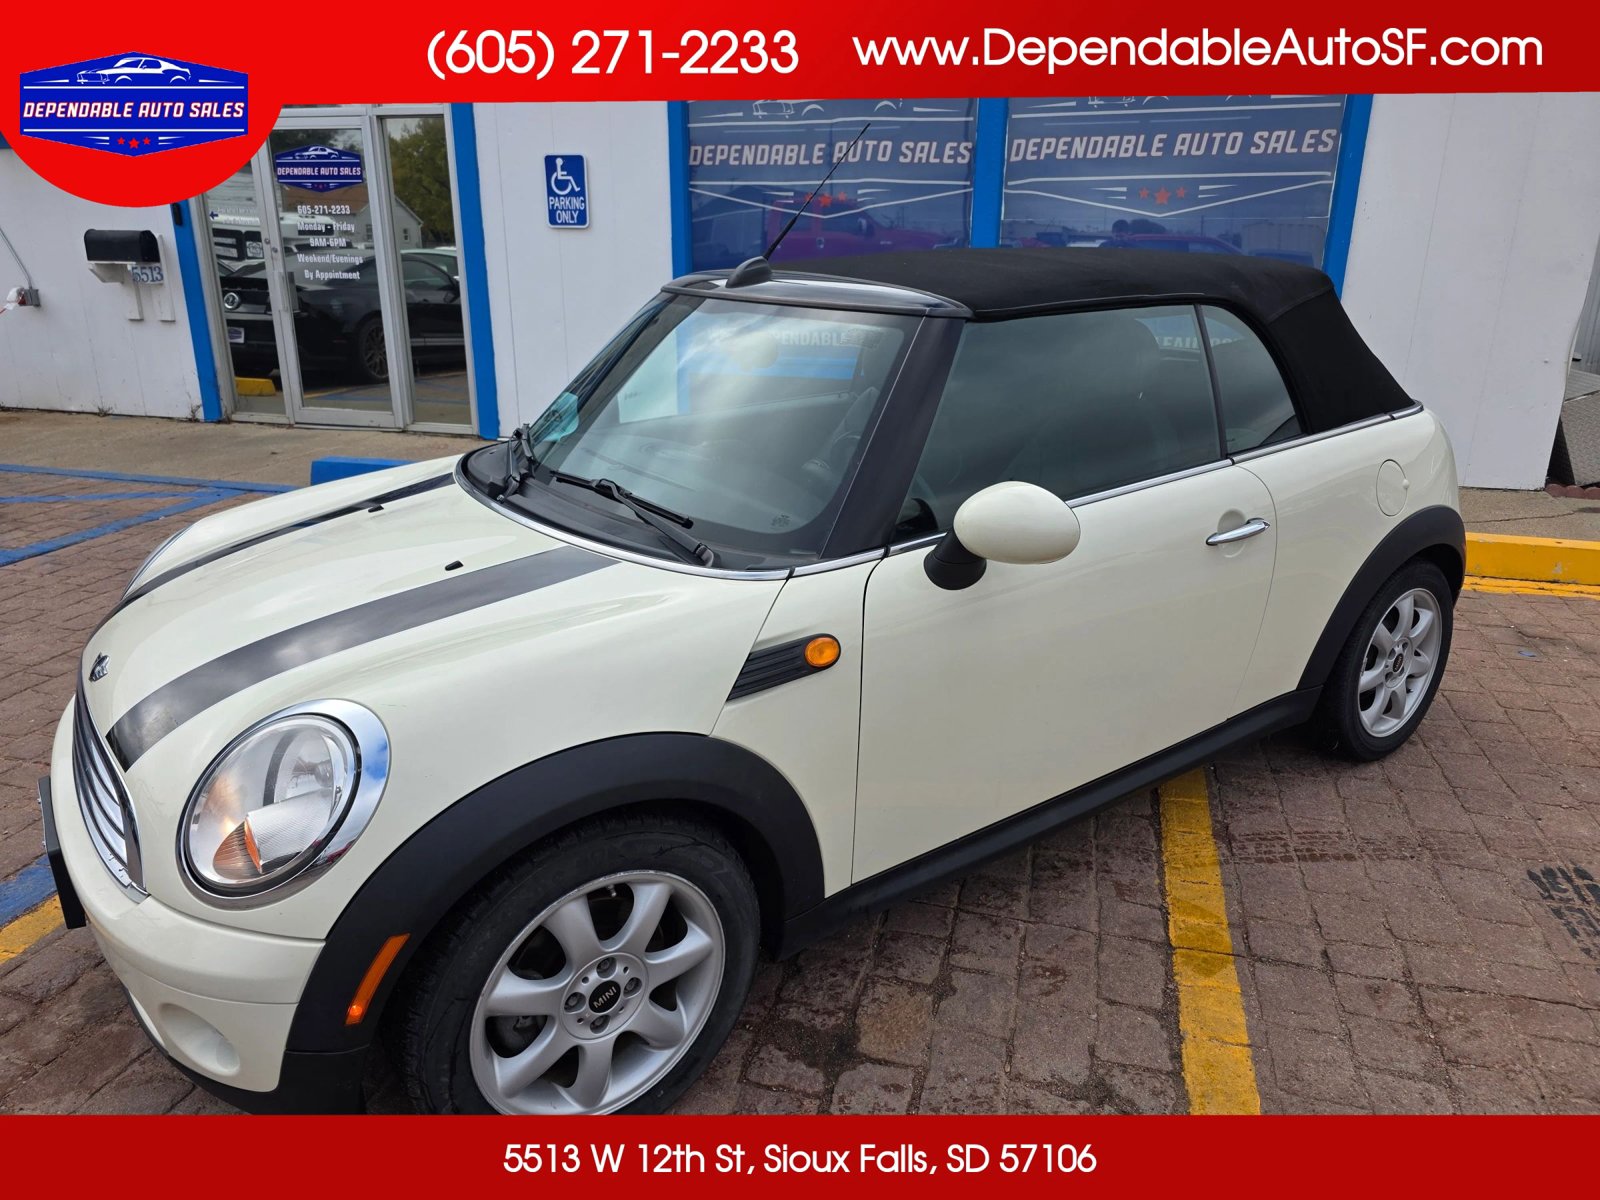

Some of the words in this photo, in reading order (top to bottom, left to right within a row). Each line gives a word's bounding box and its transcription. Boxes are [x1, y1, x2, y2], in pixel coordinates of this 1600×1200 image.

[1009, 133, 1168, 163] DEPENDABLE
[1173, 131, 1245, 157] AUTO
[1250, 128, 1337, 155] SALES
[688, 143, 826, 166] DEPENDABLE
[832, 140, 893, 164] AUTO
[899, 141, 973, 165] SALES
[277, 167, 319, 176] DEPENDABLE
[320, 167, 338, 176] AUTO
[339, 167, 361, 176] SALES
[297, 205, 351, 215] 605-271-2233
[549, 196, 585, 210] PARKING
[556, 210, 579, 224] ONLY
[297, 222, 326, 233] Monday
[333, 221, 355, 233] Friday
[131, 265, 164, 283] 5513
[304, 270, 313, 281] By
[315, 270, 361, 281] Appointment
[593, 986, 617, 1009] MINI
